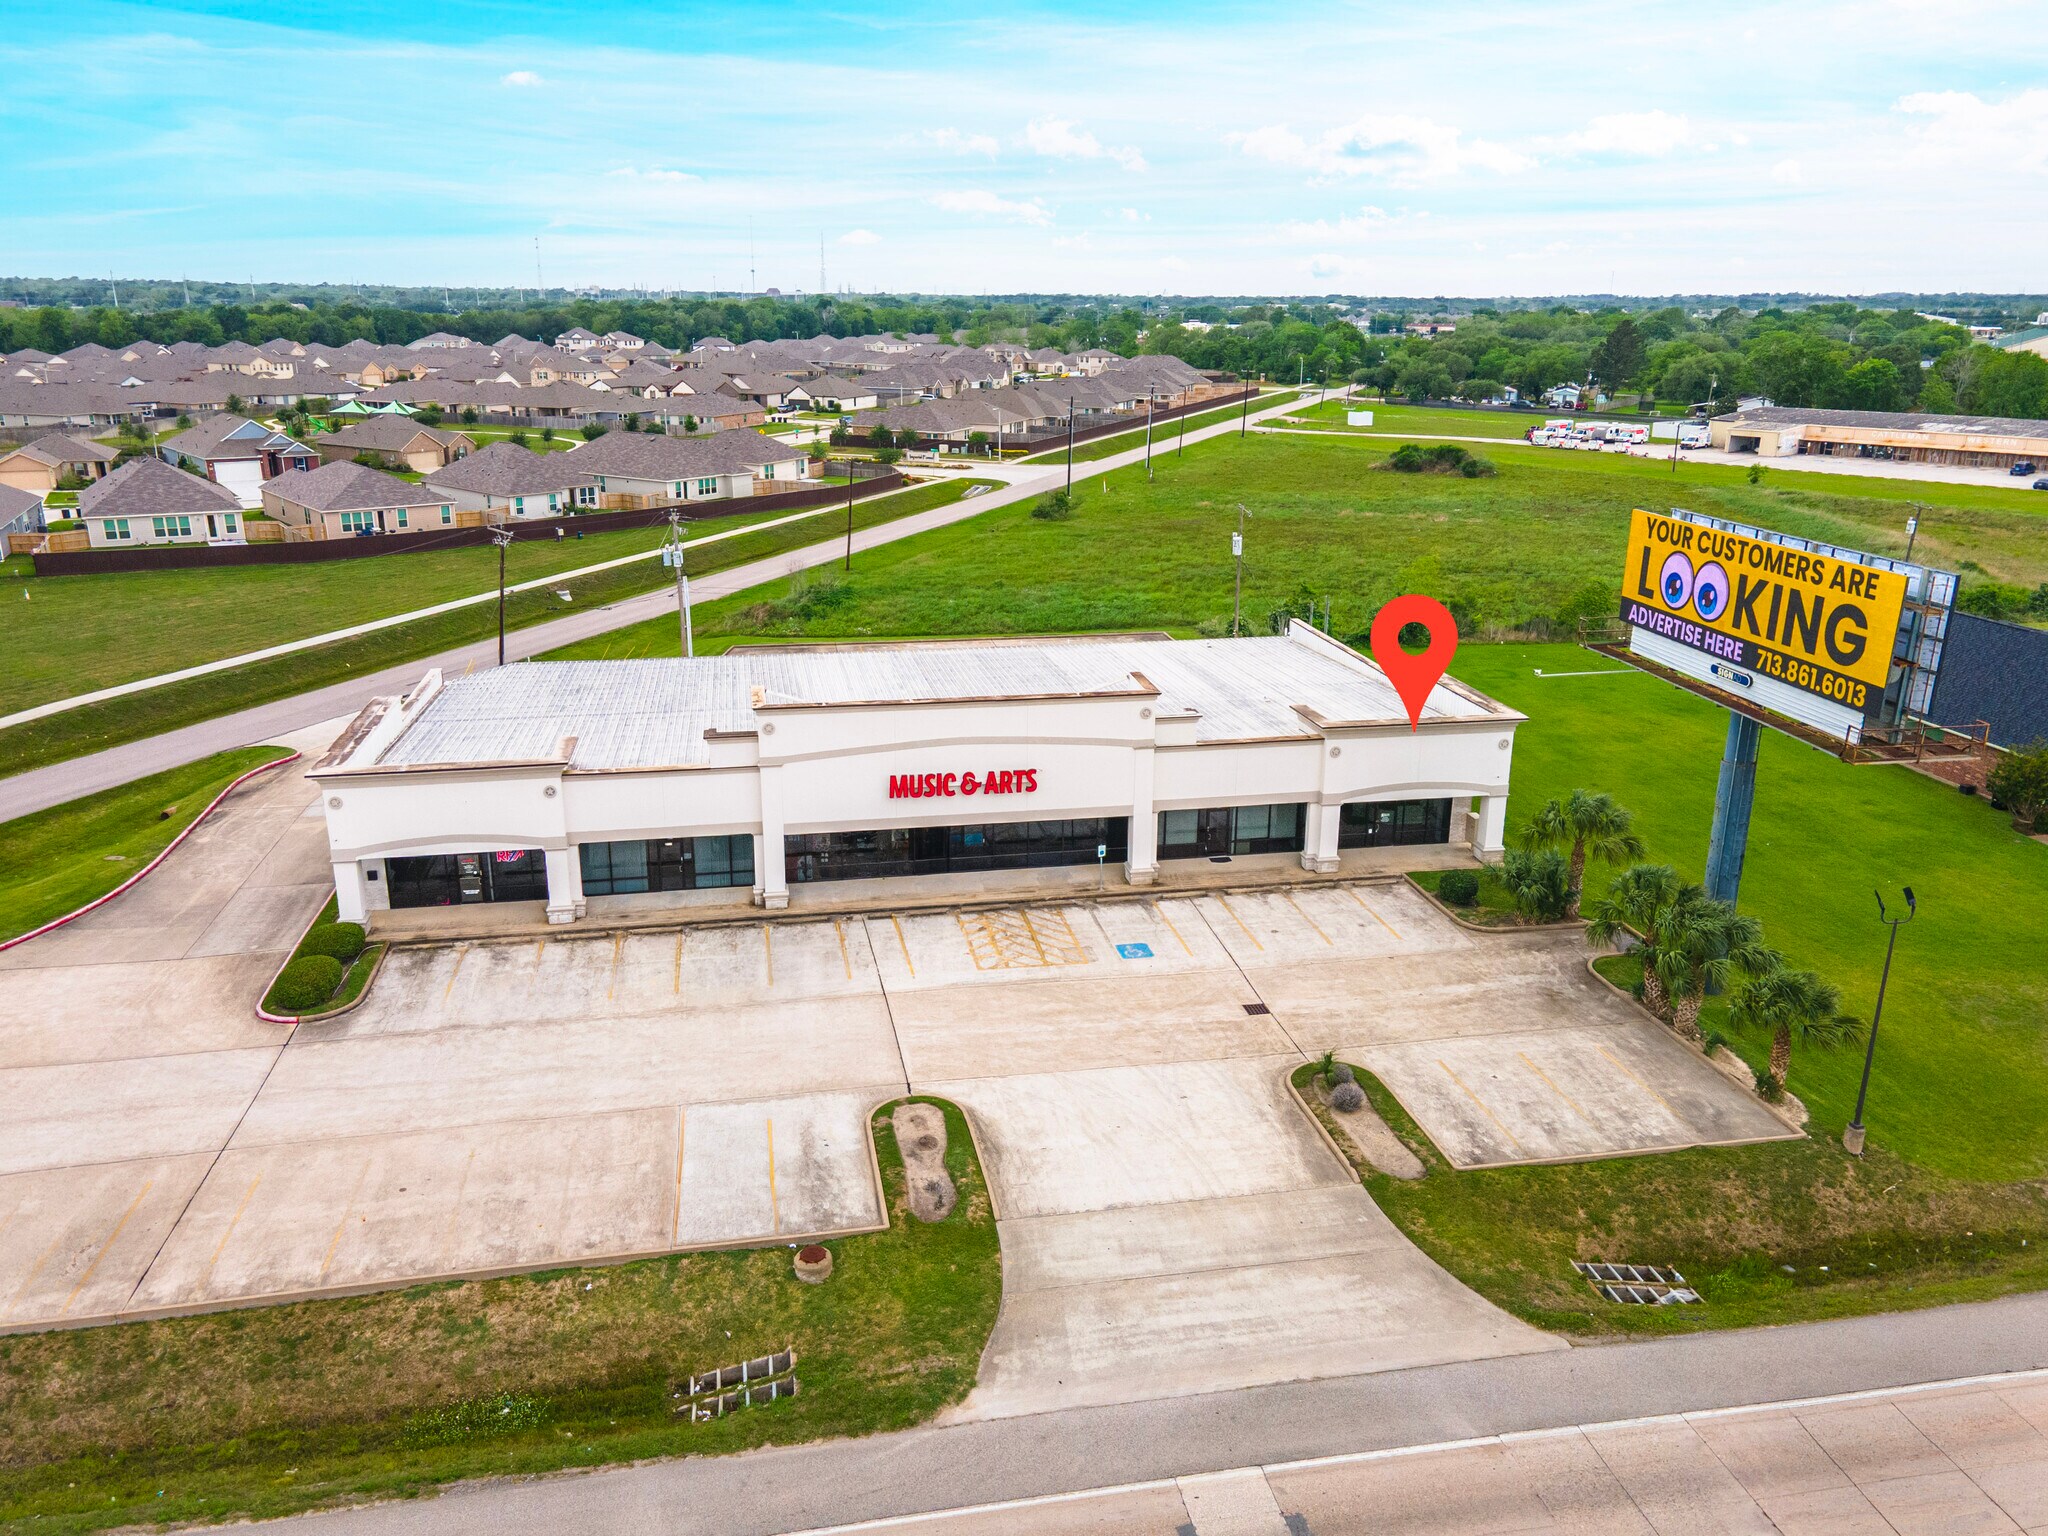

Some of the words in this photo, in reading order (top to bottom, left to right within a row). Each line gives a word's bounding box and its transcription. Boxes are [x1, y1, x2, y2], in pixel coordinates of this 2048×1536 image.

[1872, 431, 1930, 441] CATTLEMAN
[1967, 436, 2017, 446] WESTERN
[1646, 516, 1693, 549] YOUR
[1697, 534, 1824, 585] CUSTOMERS
[1829, 566, 1880, 600] ARE
[1628, 603, 1702, 648] ADVERTISE
[1705, 630, 1743, 662] HERE
[1755, 648, 1867, 708] 713.861.6013
[889, 773, 956, 799] MUSIC
[960, 771, 982, 795] &
[984, 768, 1038, 795] ARTS
